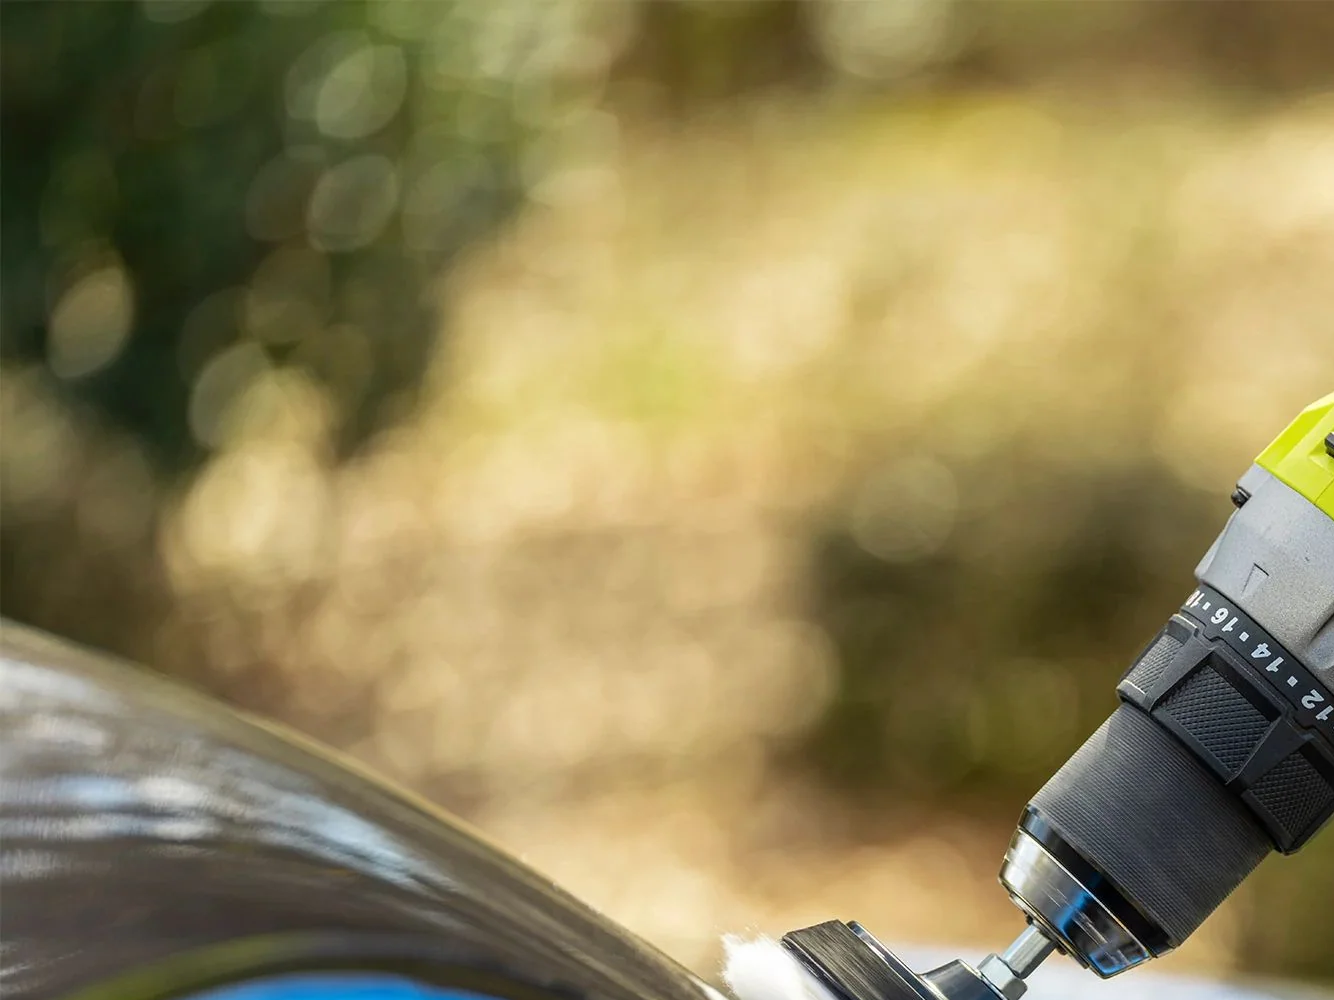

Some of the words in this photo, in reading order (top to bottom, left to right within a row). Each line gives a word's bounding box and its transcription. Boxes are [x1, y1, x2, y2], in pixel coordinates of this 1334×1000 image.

[1210, 607, 1239, 632] 16
[1251, 643, 1285, 673] 14
[1301, 689, 1334, 721] 12
